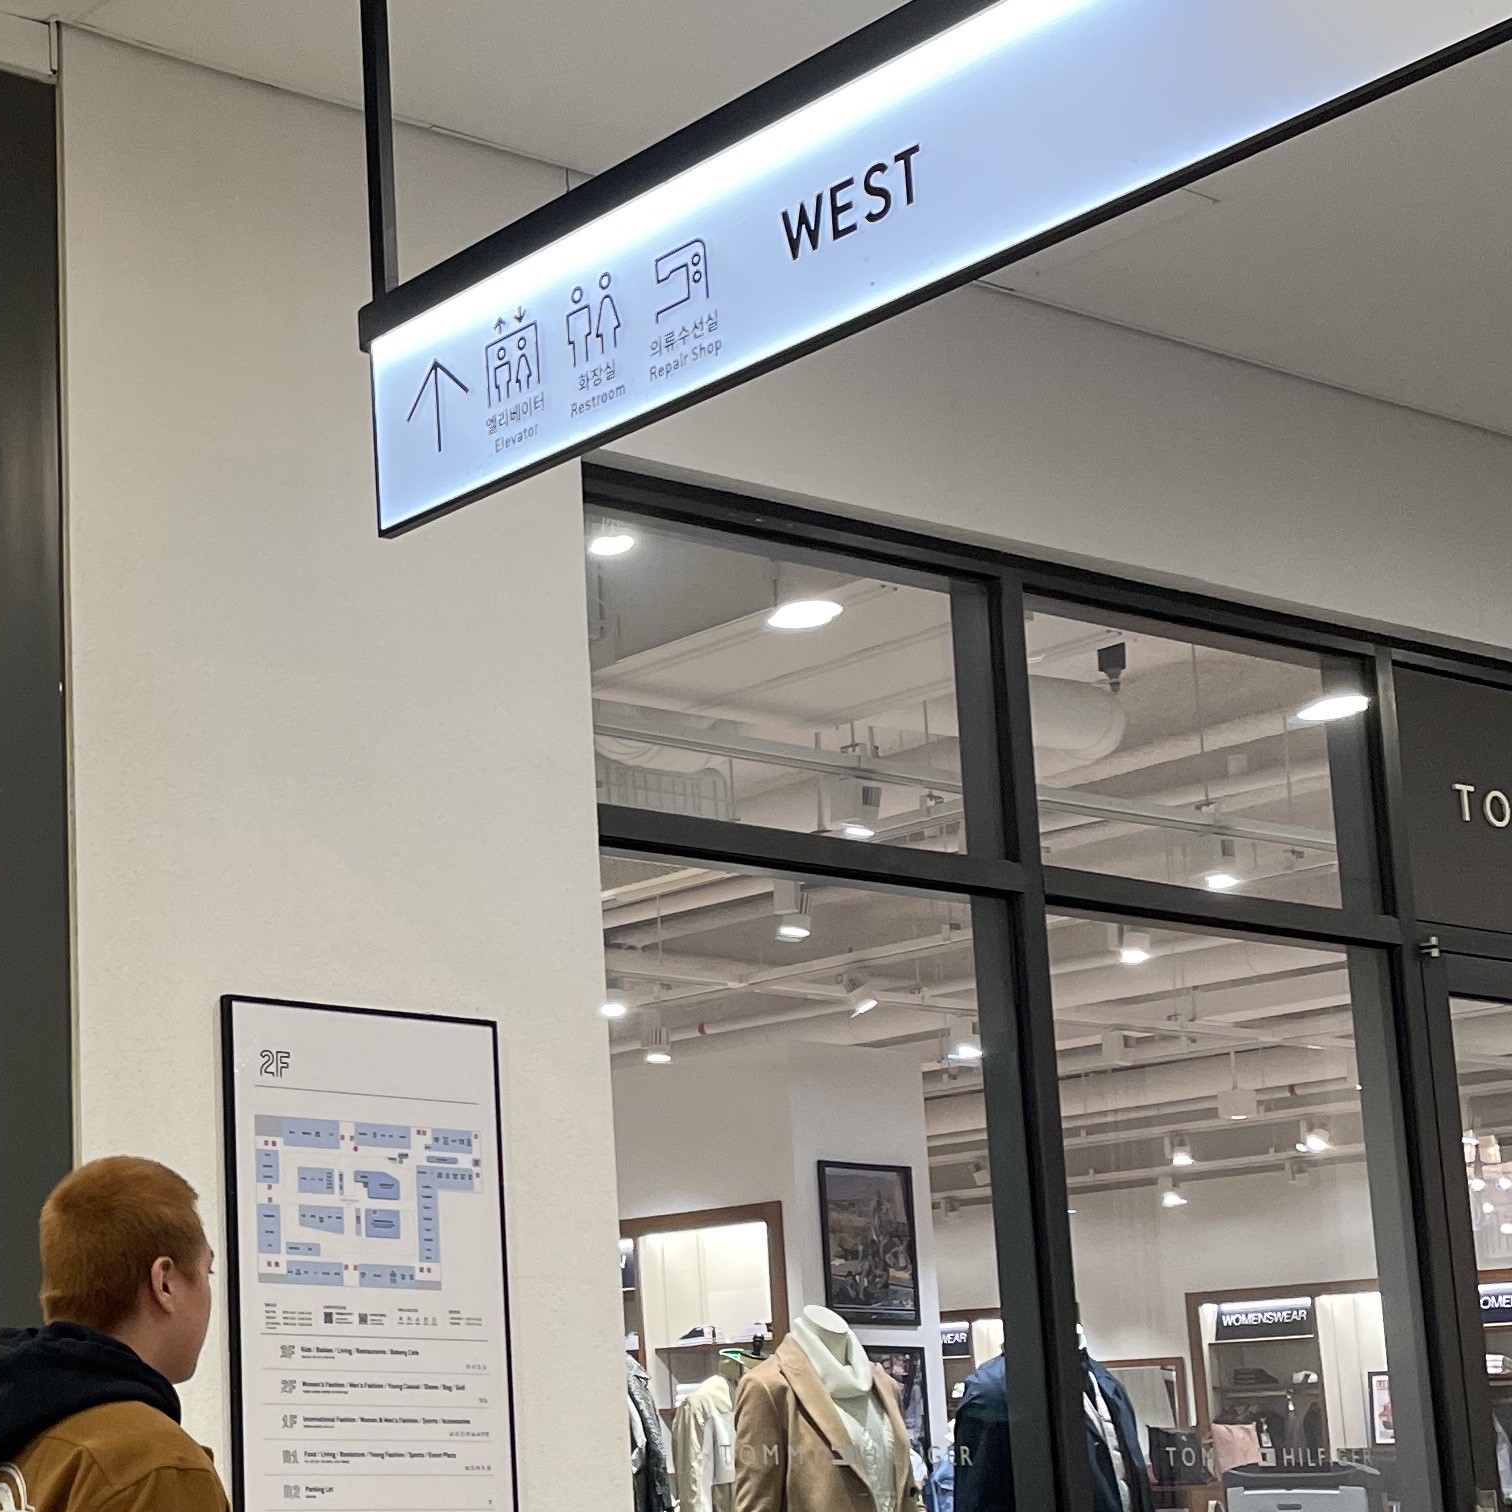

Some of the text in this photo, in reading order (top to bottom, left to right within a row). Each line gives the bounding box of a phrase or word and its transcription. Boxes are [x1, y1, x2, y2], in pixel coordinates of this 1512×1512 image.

[781, 143, 920, 261] WEST
[649, 309, 719, 357] 의류수선실
[577, 359, 617, 391] 화장실
[649, 338, 723, 381] Repair Shop
[485, 391, 545, 436] 엘리베이터
[570, 383, 627, 418] Restroom
[494, 423, 540, 453] Elevator
[1452, 783, 1511, 828] TO
[259, 1049, 291, 1078] 2F
[1221, 1309, 1308, 1327] WOMENSWEAR
